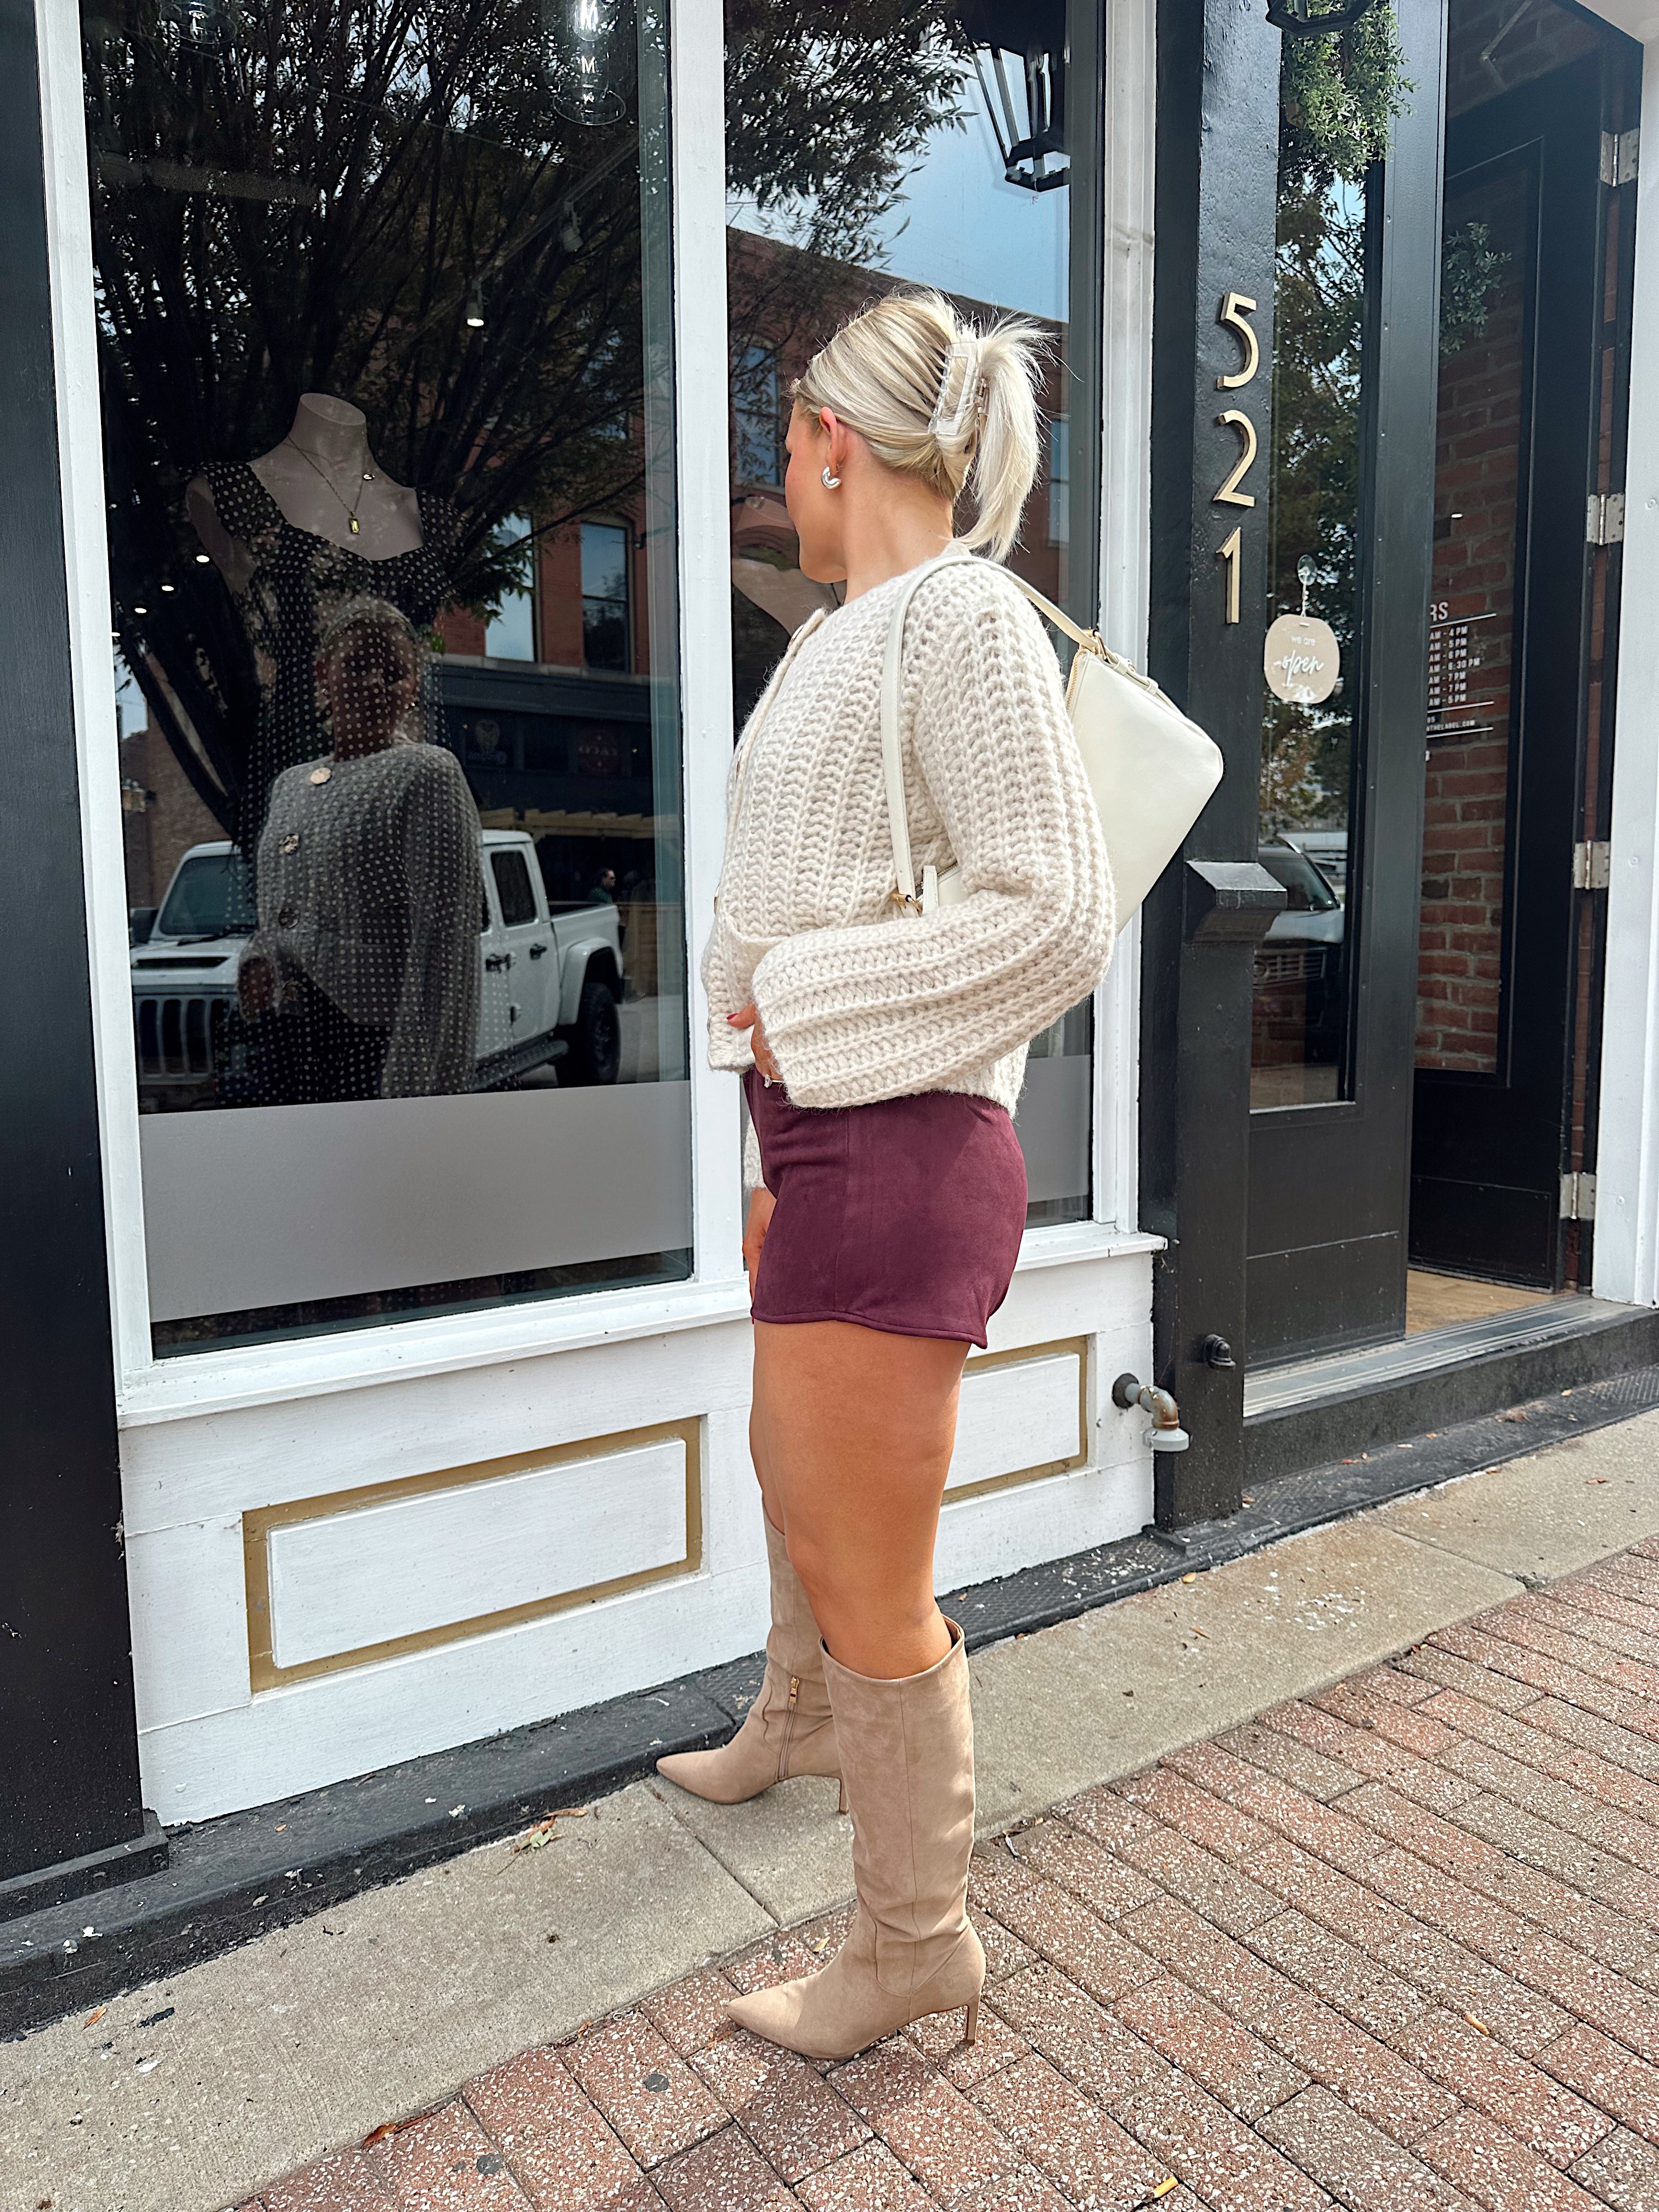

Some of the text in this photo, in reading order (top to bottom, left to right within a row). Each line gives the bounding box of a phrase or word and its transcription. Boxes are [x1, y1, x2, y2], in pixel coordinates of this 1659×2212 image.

[1213, 292, 1260, 624] 521
[1429, 631, 1441, 640] AM
[1455, 625, 1468, 635] PM
[1304, 637, 1316, 646] are
[1429, 642, 1441, 651] AM
[1455, 637, 1467, 647] PM
[1429, 653, 1440, 662] AM
[1455, 648, 1467, 658] PM
[1280, 650, 1324, 687] open
[1429, 664, 1440, 673] AM
[1468, 658, 1480, 668] PM
[1429, 676, 1440, 684] AM
[1448, 673, 1453, 681] 7
[1454, 672, 1466, 681] PM
[1429, 686, 1441, 695] AM
[1448, 685, 1453, 693] 7
[1454, 682, 1466, 692] PM
[1429, 697, 1441, 706] AM
[1454, 693, 1466, 703] PM
